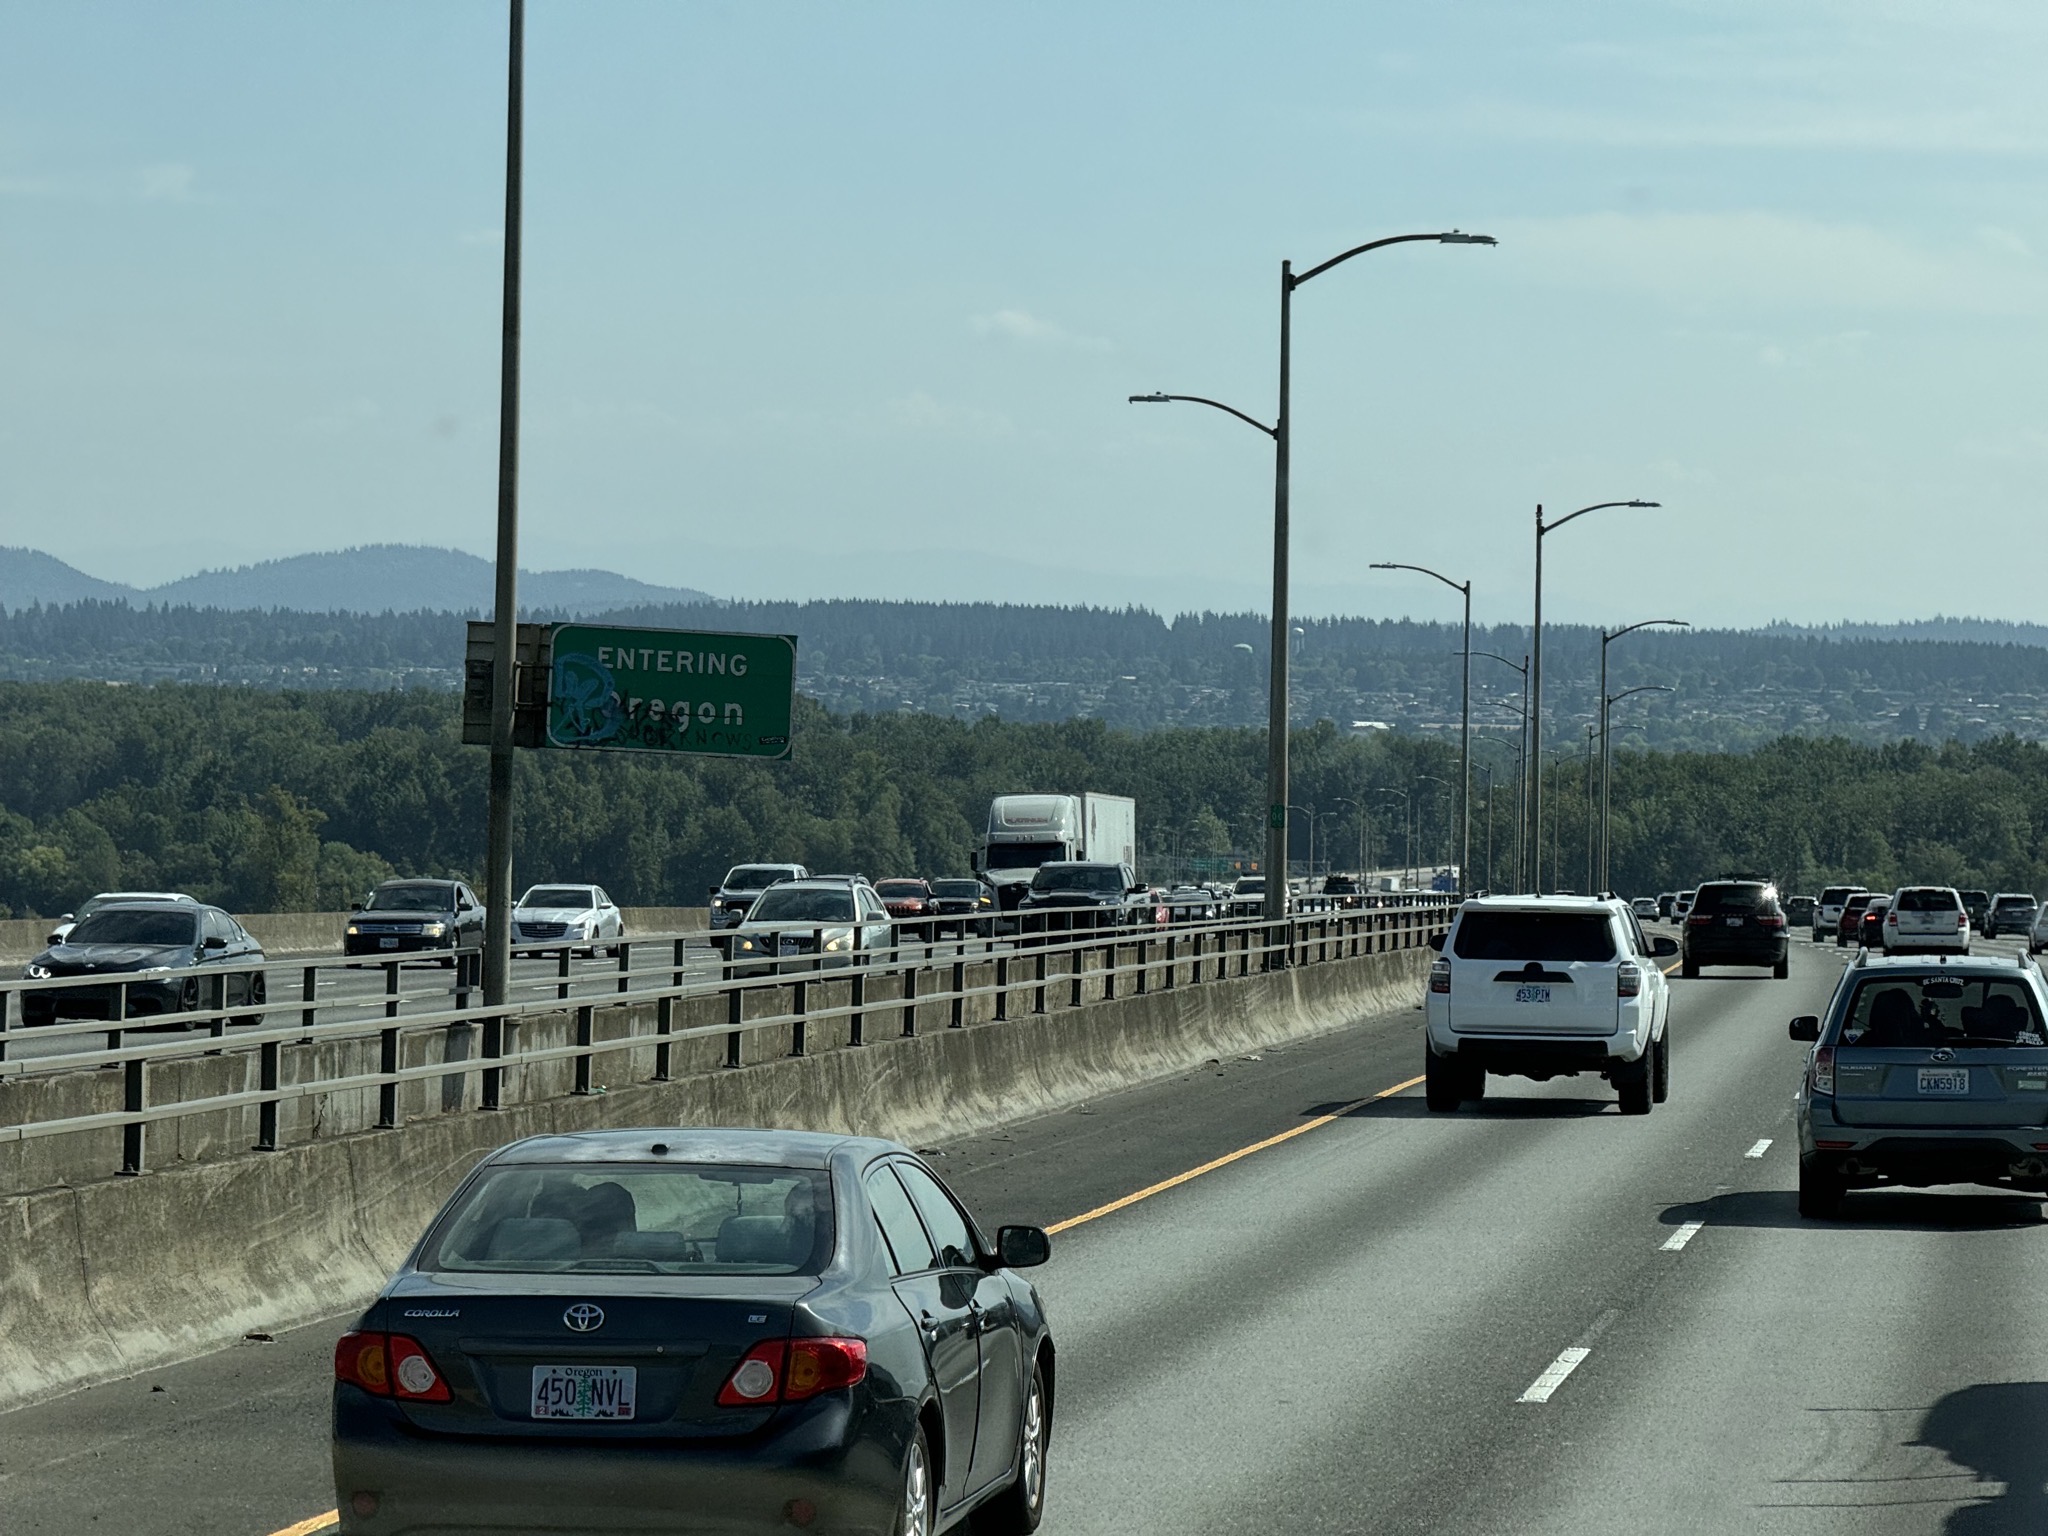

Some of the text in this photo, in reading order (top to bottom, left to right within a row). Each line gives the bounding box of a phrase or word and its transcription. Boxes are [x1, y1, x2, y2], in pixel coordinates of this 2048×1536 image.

[598, 646, 748, 677] ENTERING
[601, 690, 744, 733] regon
[1930, 976, 1949, 984] SANTA
[1920, 1078, 1966, 1090] CKN5918
[404, 1309, 460, 1318] COROLLA
[565, 1367, 603, 1378] Oregon
[537, 1378, 630, 1406] 450 NVL
